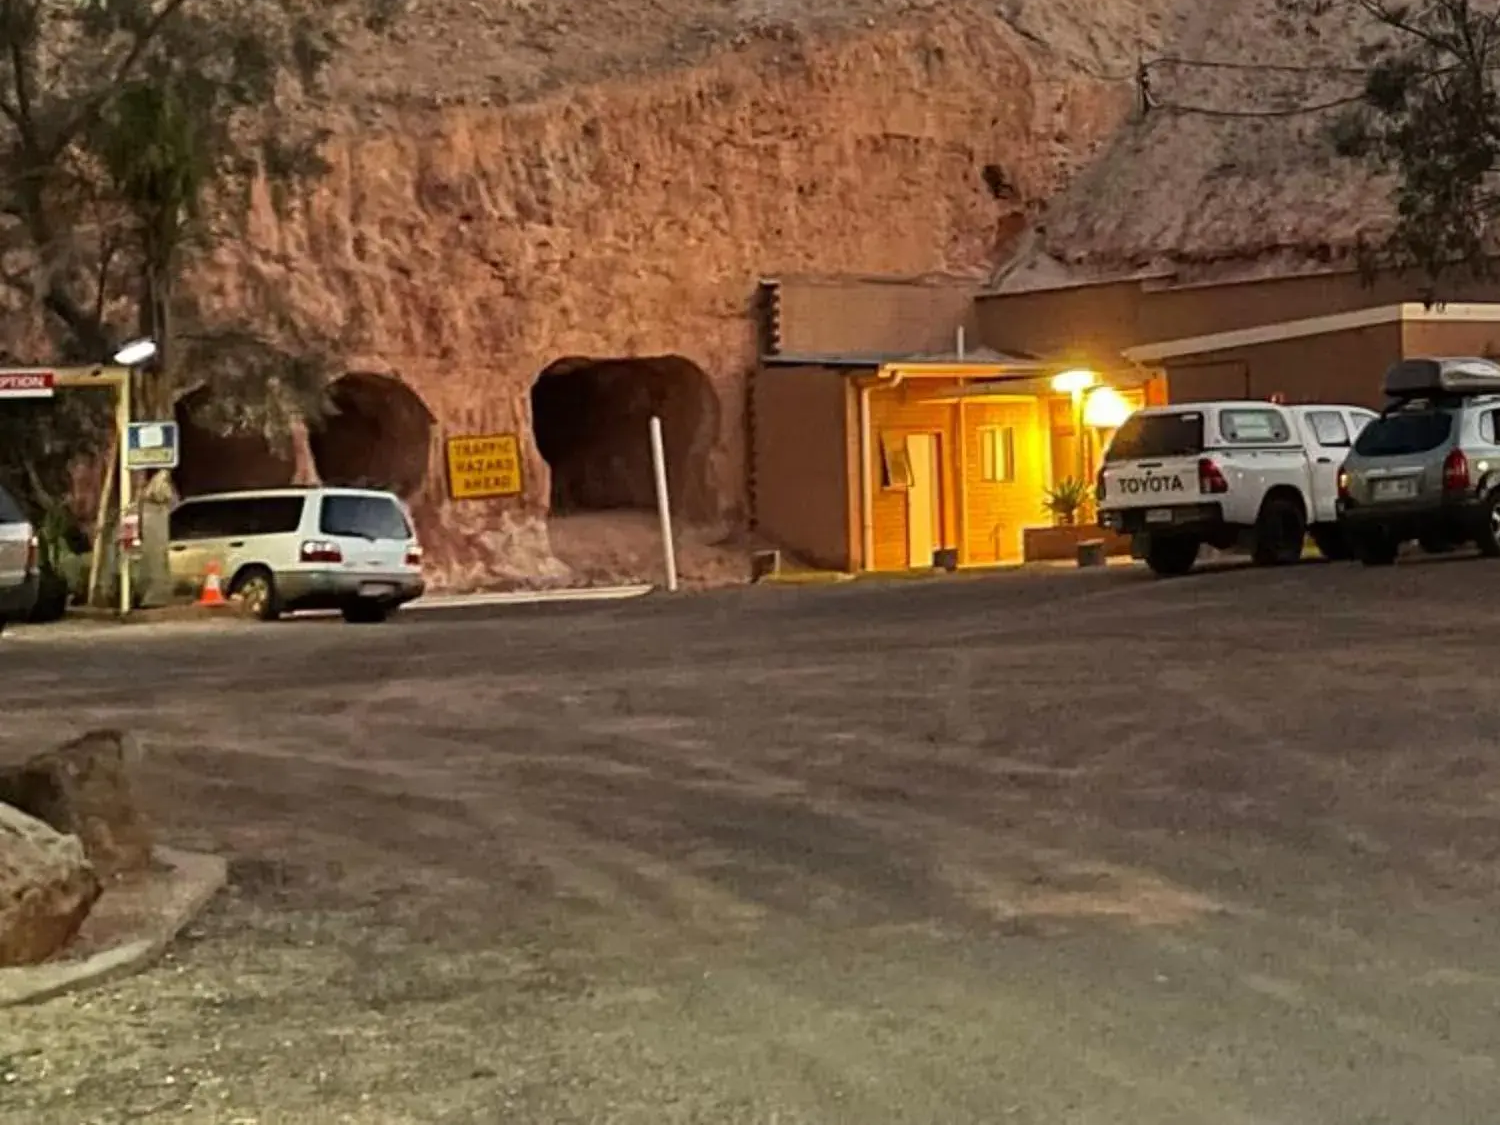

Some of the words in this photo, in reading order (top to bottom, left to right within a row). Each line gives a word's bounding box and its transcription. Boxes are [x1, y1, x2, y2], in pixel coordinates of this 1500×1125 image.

[454, 440, 513, 455] TRAFFIC
[455, 458, 514, 473] HAZARD
[463, 475, 512, 491] AHEAD
[1118, 475, 1184, 493] TOYOTA
